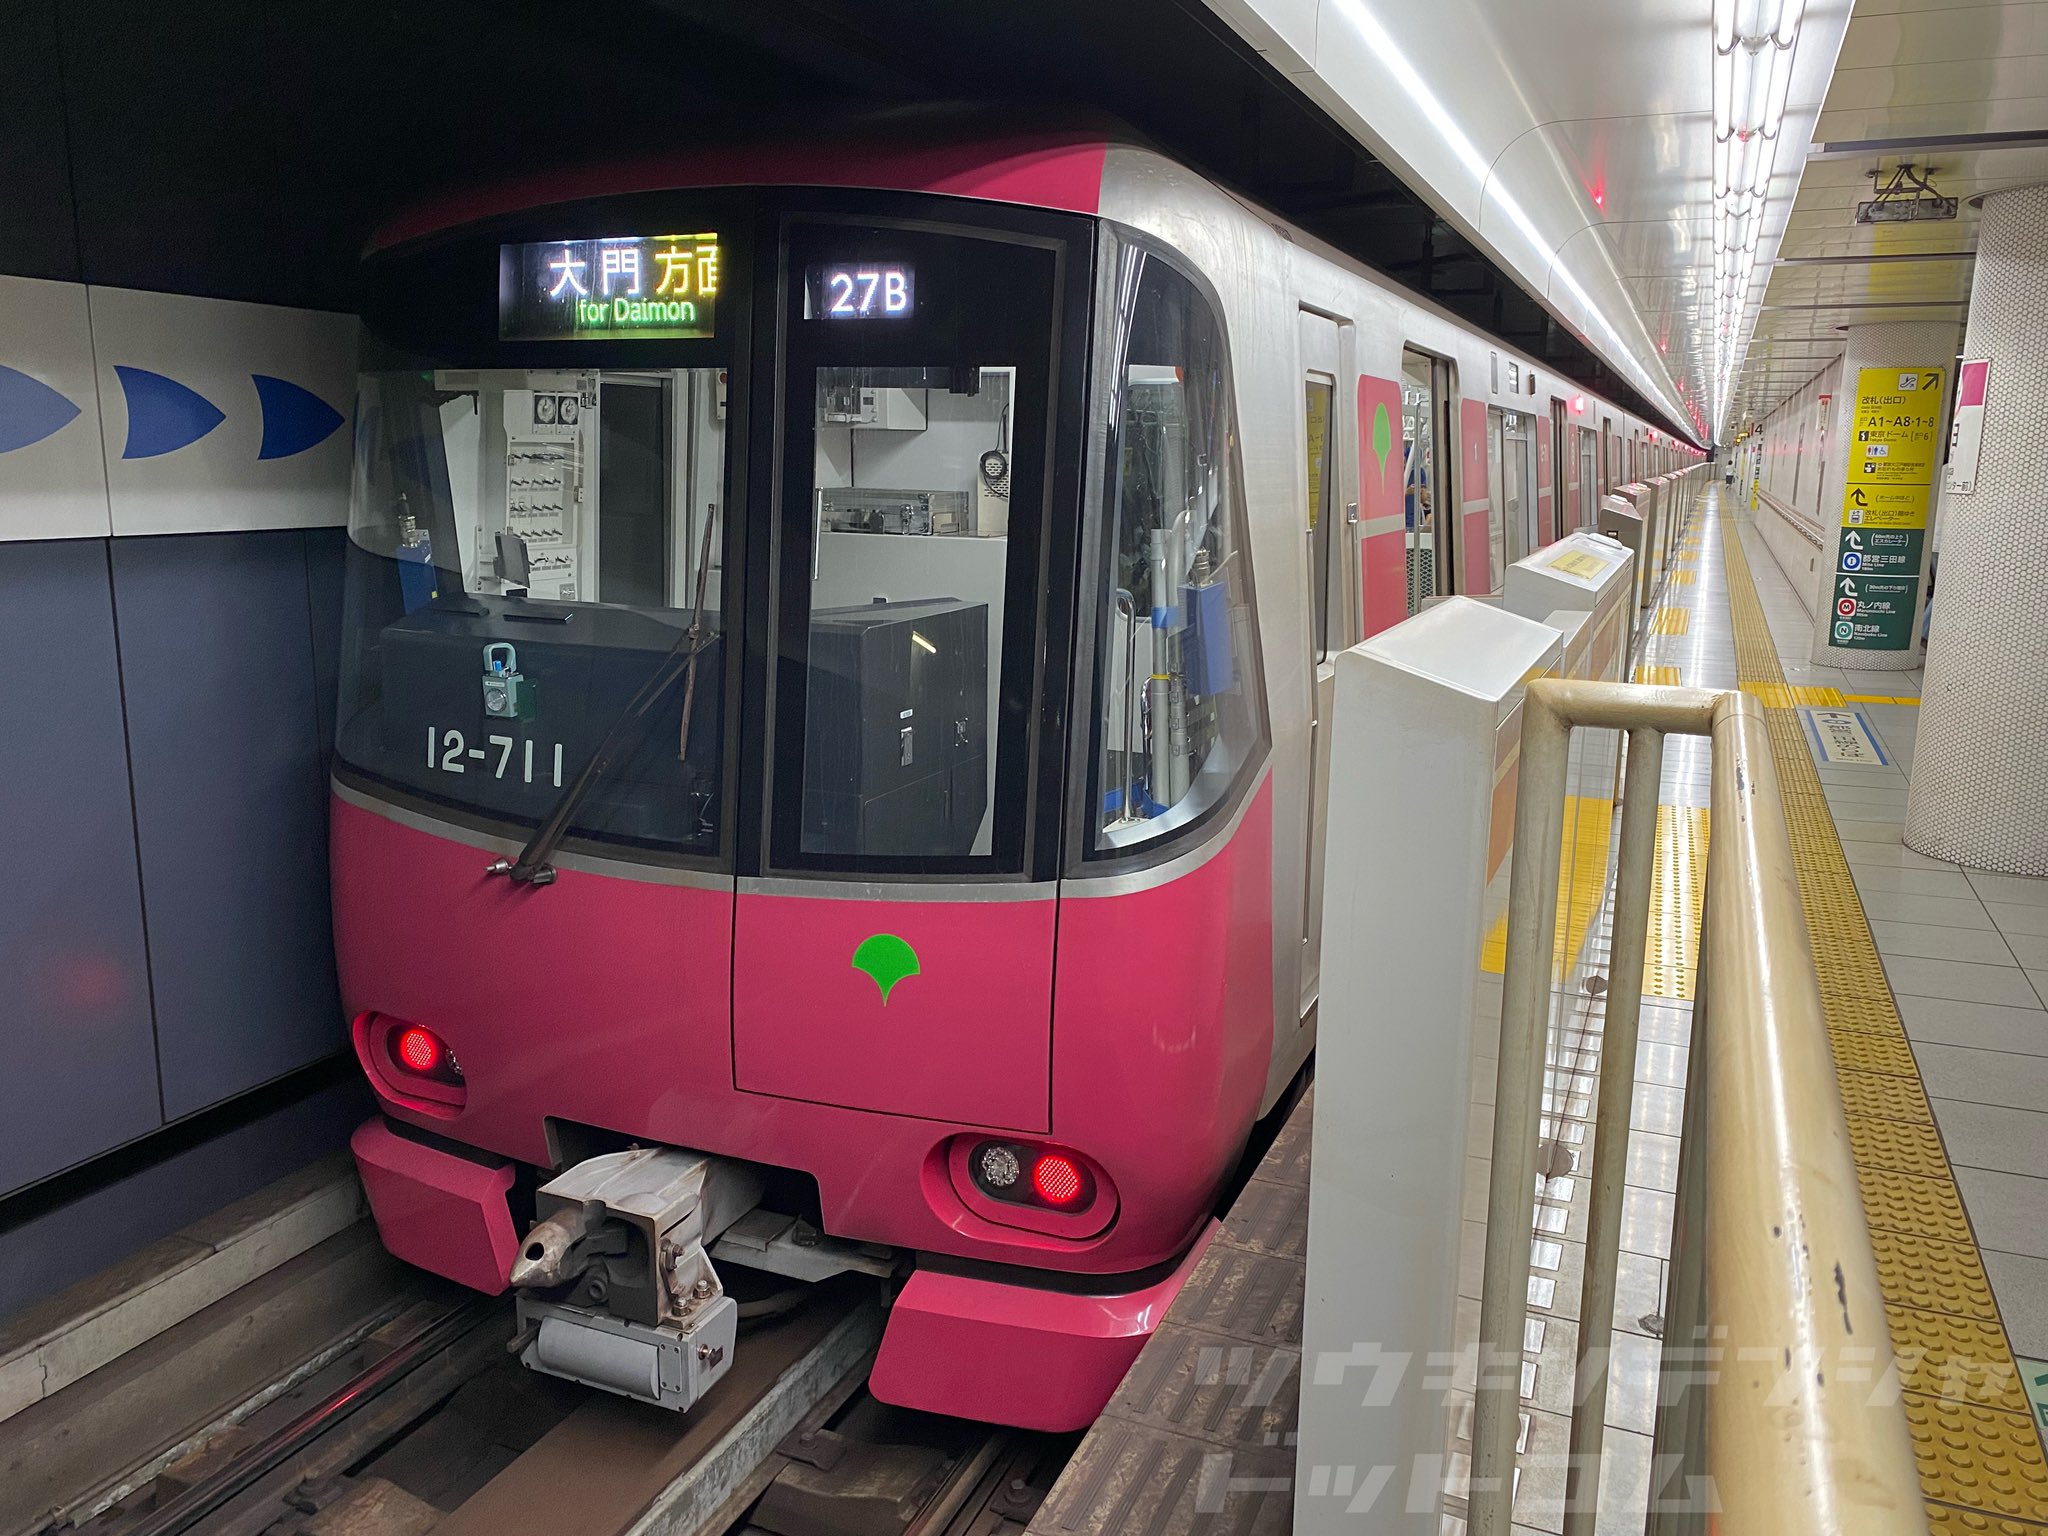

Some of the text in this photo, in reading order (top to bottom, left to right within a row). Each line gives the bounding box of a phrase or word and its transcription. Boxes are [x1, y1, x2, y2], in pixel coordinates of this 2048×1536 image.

[830, 272, 907, 312] 27B
[580, 297, 696, 322] for Daimon
[1863, 555, 1906, 563] 都営三田線
[1857, 601, 1890, 610] 丸ノ内線
[1854, 624, 1879, 632] 南北線
[428, 727, 563, 787] 12-711
